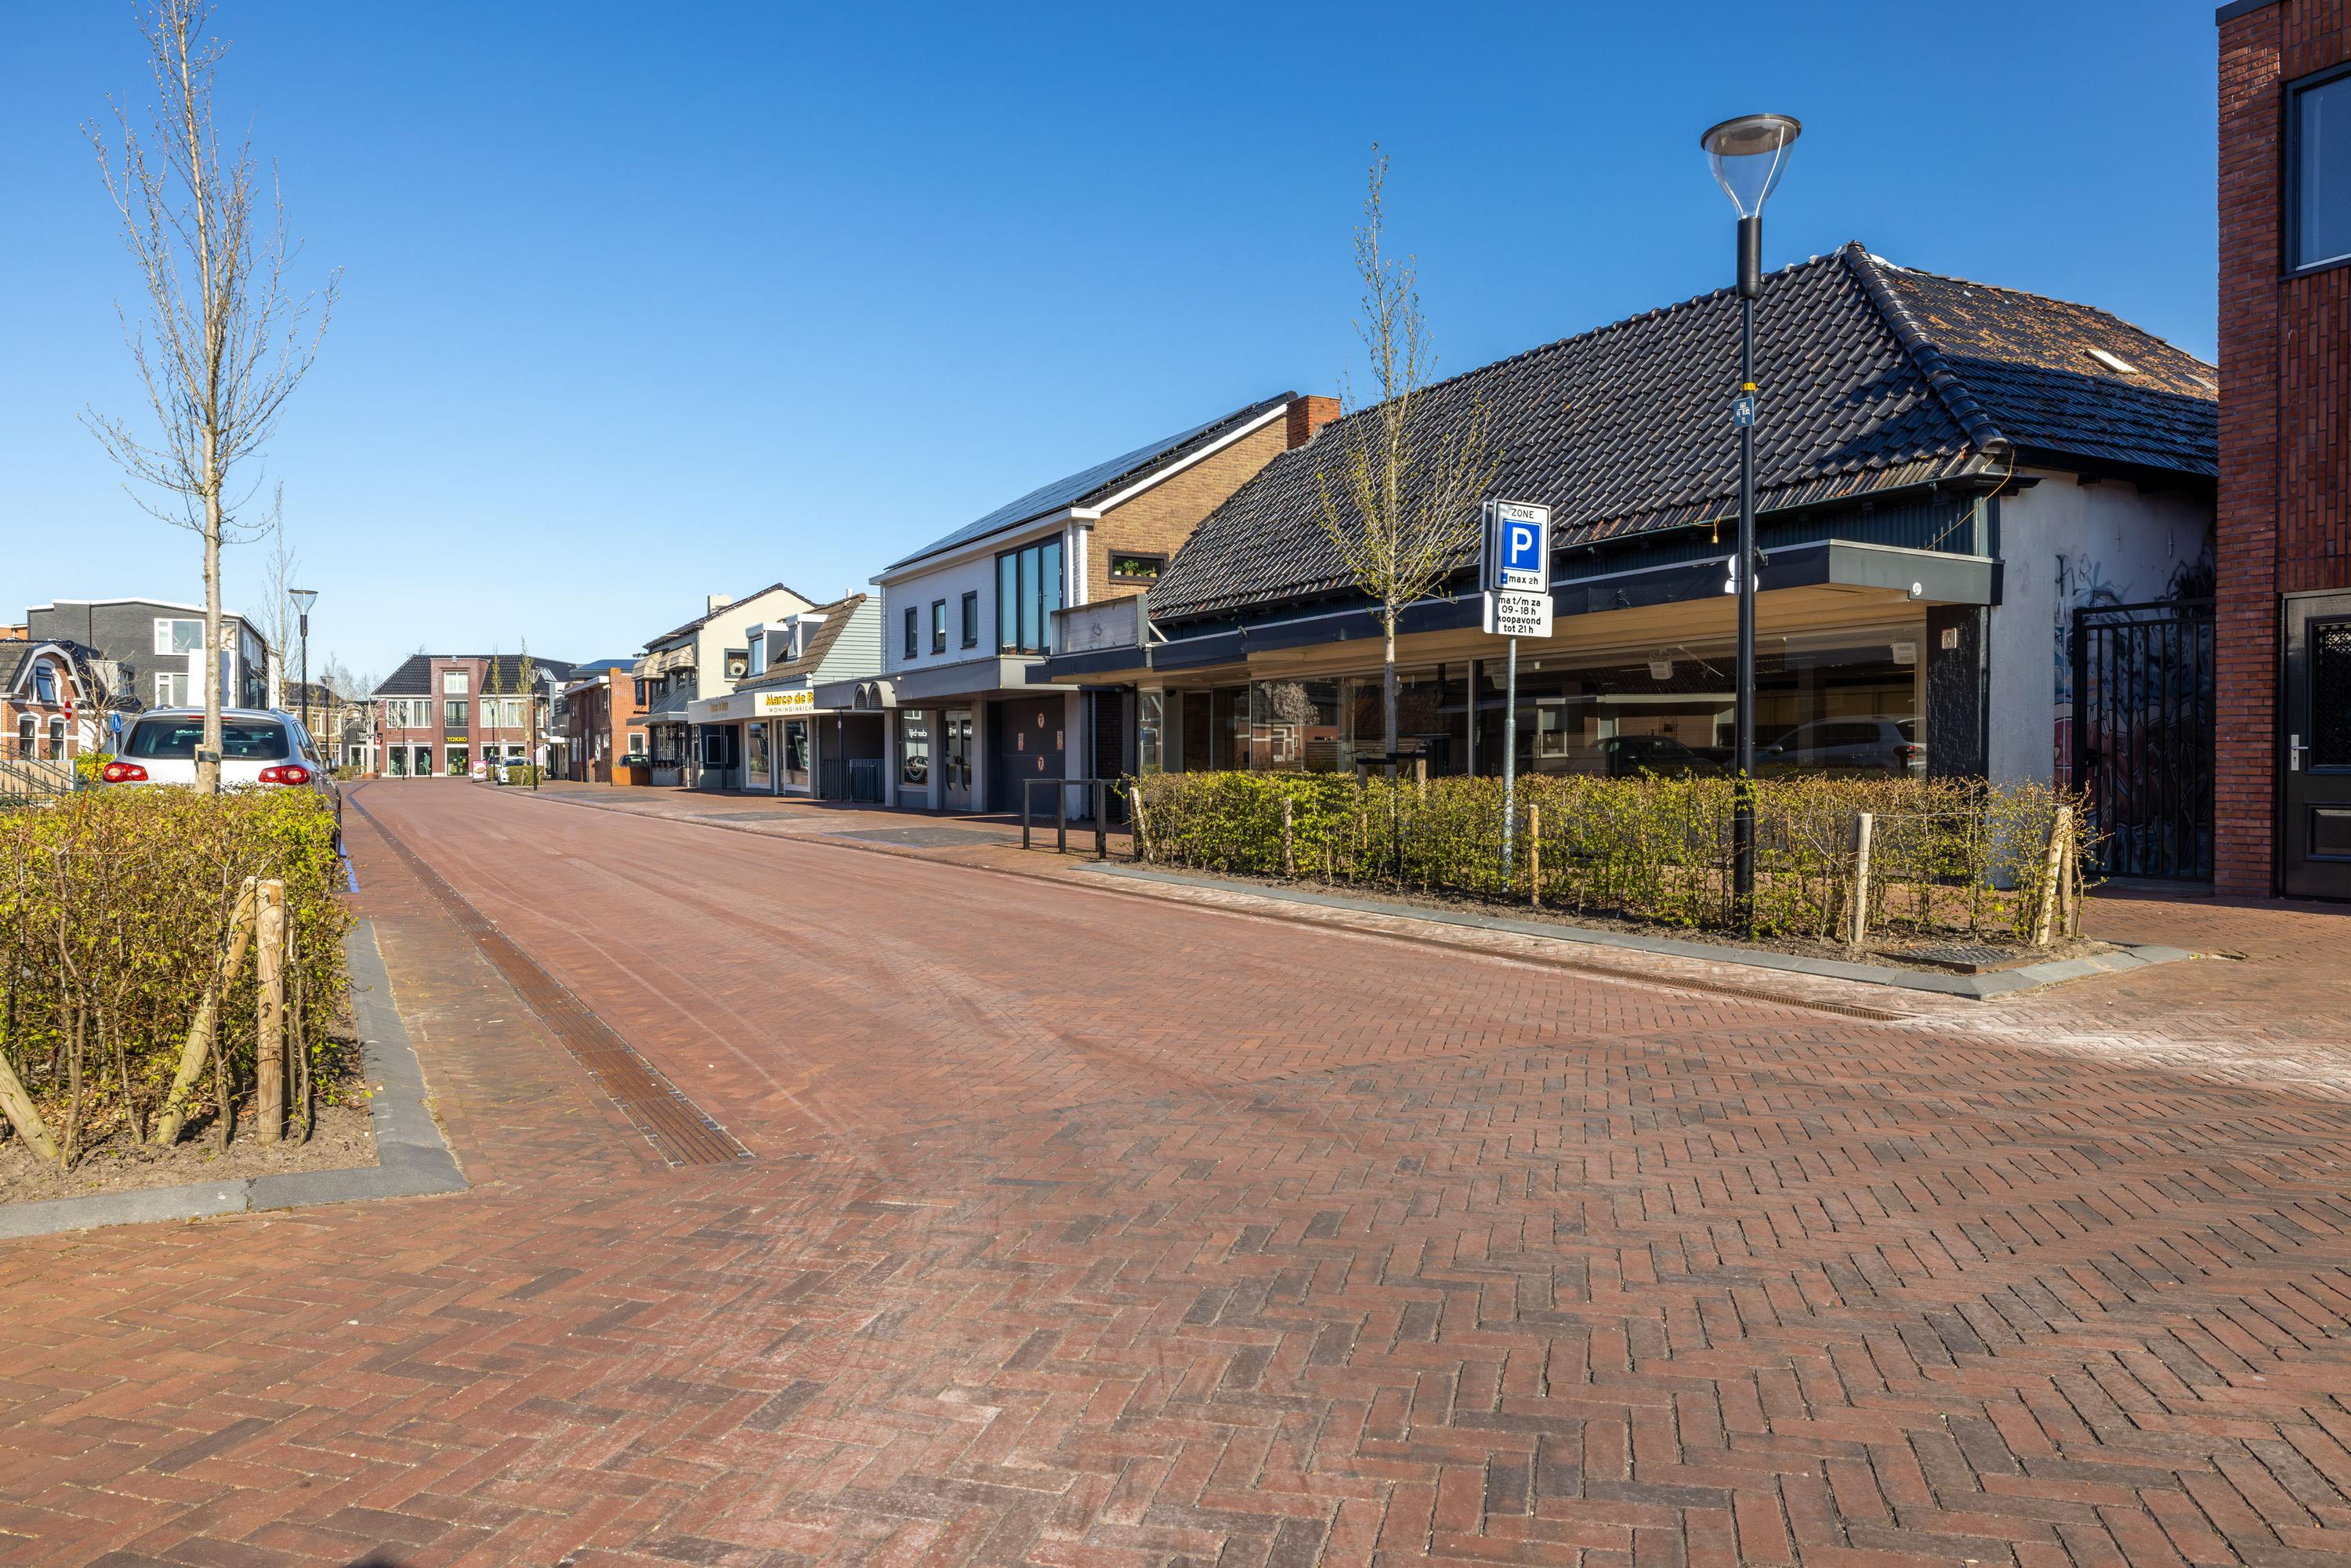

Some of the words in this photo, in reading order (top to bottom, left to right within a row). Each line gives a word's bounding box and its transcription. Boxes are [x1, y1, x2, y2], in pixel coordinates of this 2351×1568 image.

[1512, 508, 1534, 519] ZONE
[1511, 527, 1533, 564] P
[1509, 575, 1527, 584] max
[1512, 596, 1529, 606] t/m
[1531, 607, 1536, 616] h
[1497, 614, 1541, 625] koopavond
[1504, 624, 1516, 632] tot
[1518, 625, 1527, 633] 21
[1528, 625, 1534, 634] h
[766, 693, 792, 706] Marco
[794, 692, 806, 704] de
[770, 704, 813, 713] WONINGINRICH
